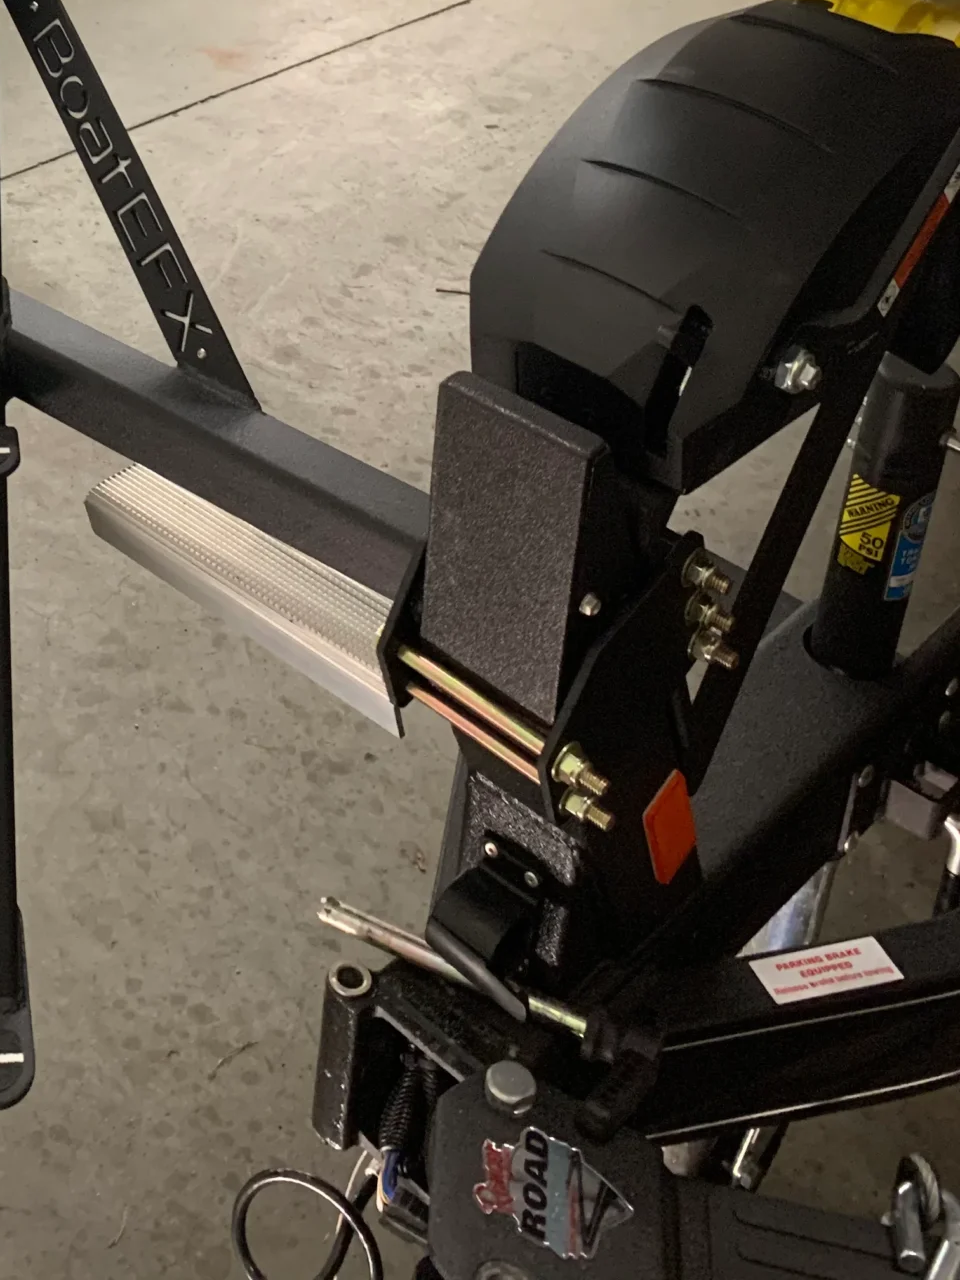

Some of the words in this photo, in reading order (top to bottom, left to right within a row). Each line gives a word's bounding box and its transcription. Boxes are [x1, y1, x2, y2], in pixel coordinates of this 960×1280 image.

[847, 497, 895, 519] WARNING
[858, 543, 879, 558] PSI
[859, 531, 884, 551] 50
[775, 955, 824, 972] PARKING
[824, 947, 862, 962] BRAKE
[799, 961, 853, 978] EQUIPPED
[521, 1131, 549, 1239] ROAD
